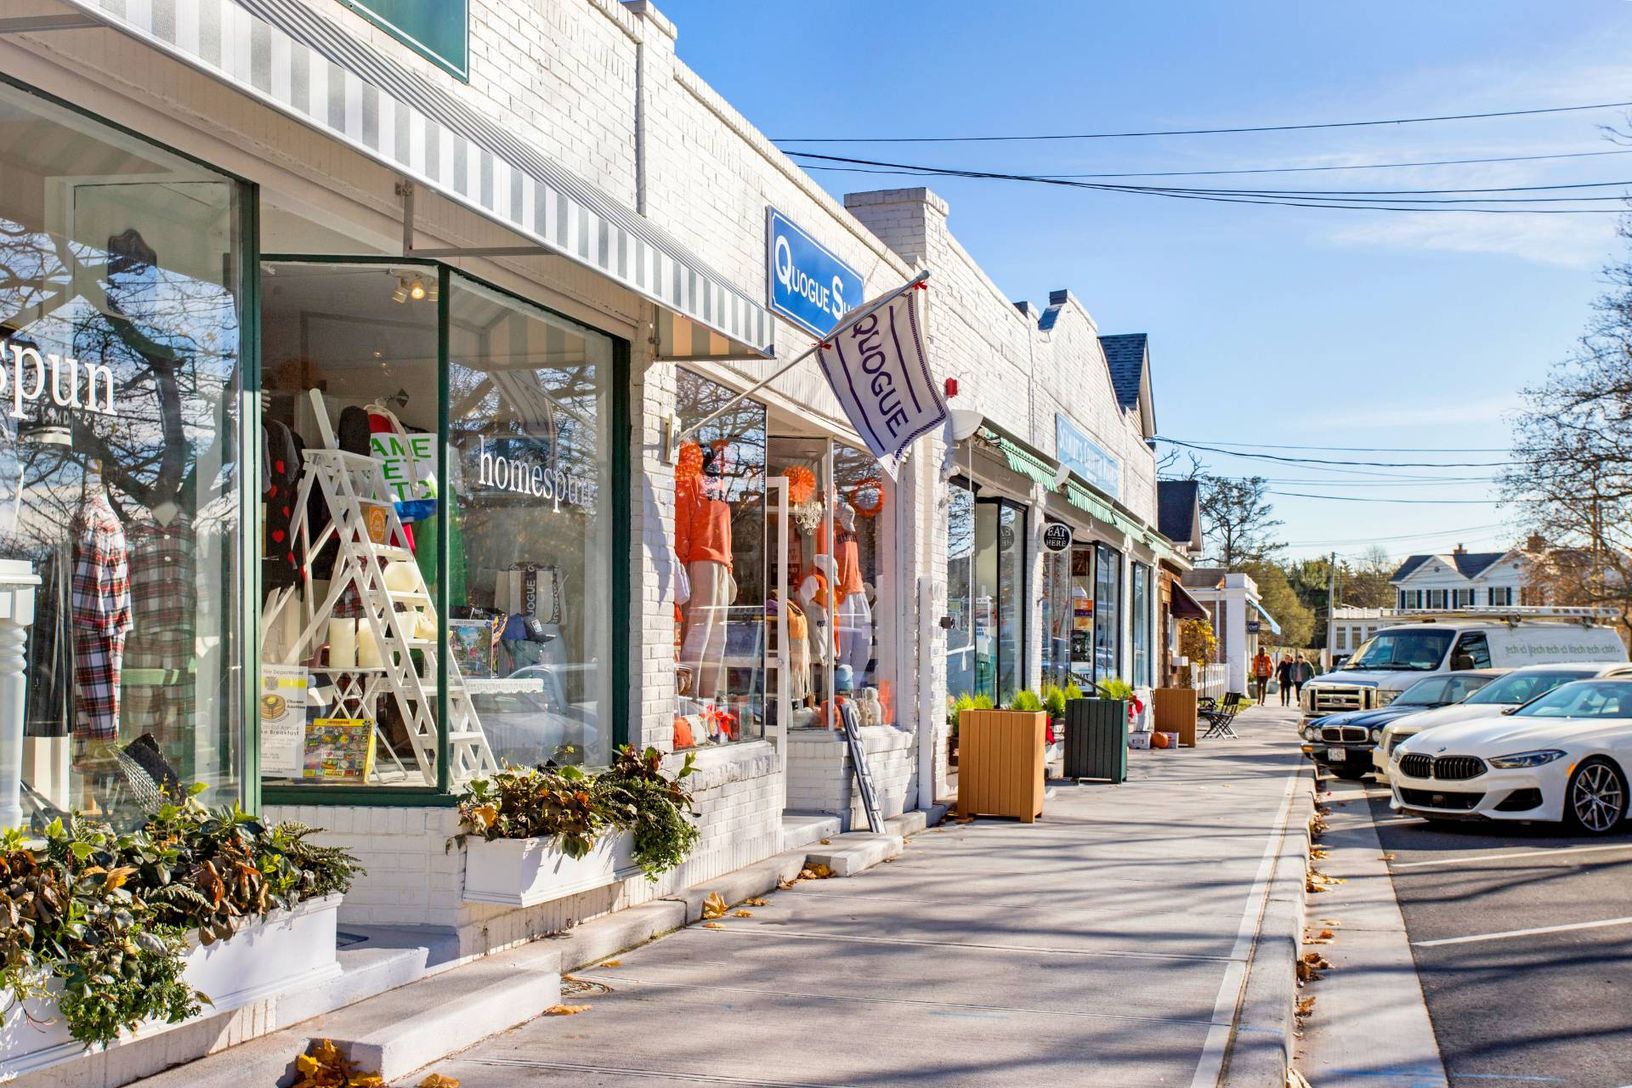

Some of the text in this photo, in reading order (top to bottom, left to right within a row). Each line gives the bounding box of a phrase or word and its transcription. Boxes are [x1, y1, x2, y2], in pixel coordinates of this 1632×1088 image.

[850, 313, 909, 439] QUOGUE
[478, 434, 593, 513] homespun
[1046, 526, 1067, 537] EAT
[1046, 539, 1067, 548] HERE
